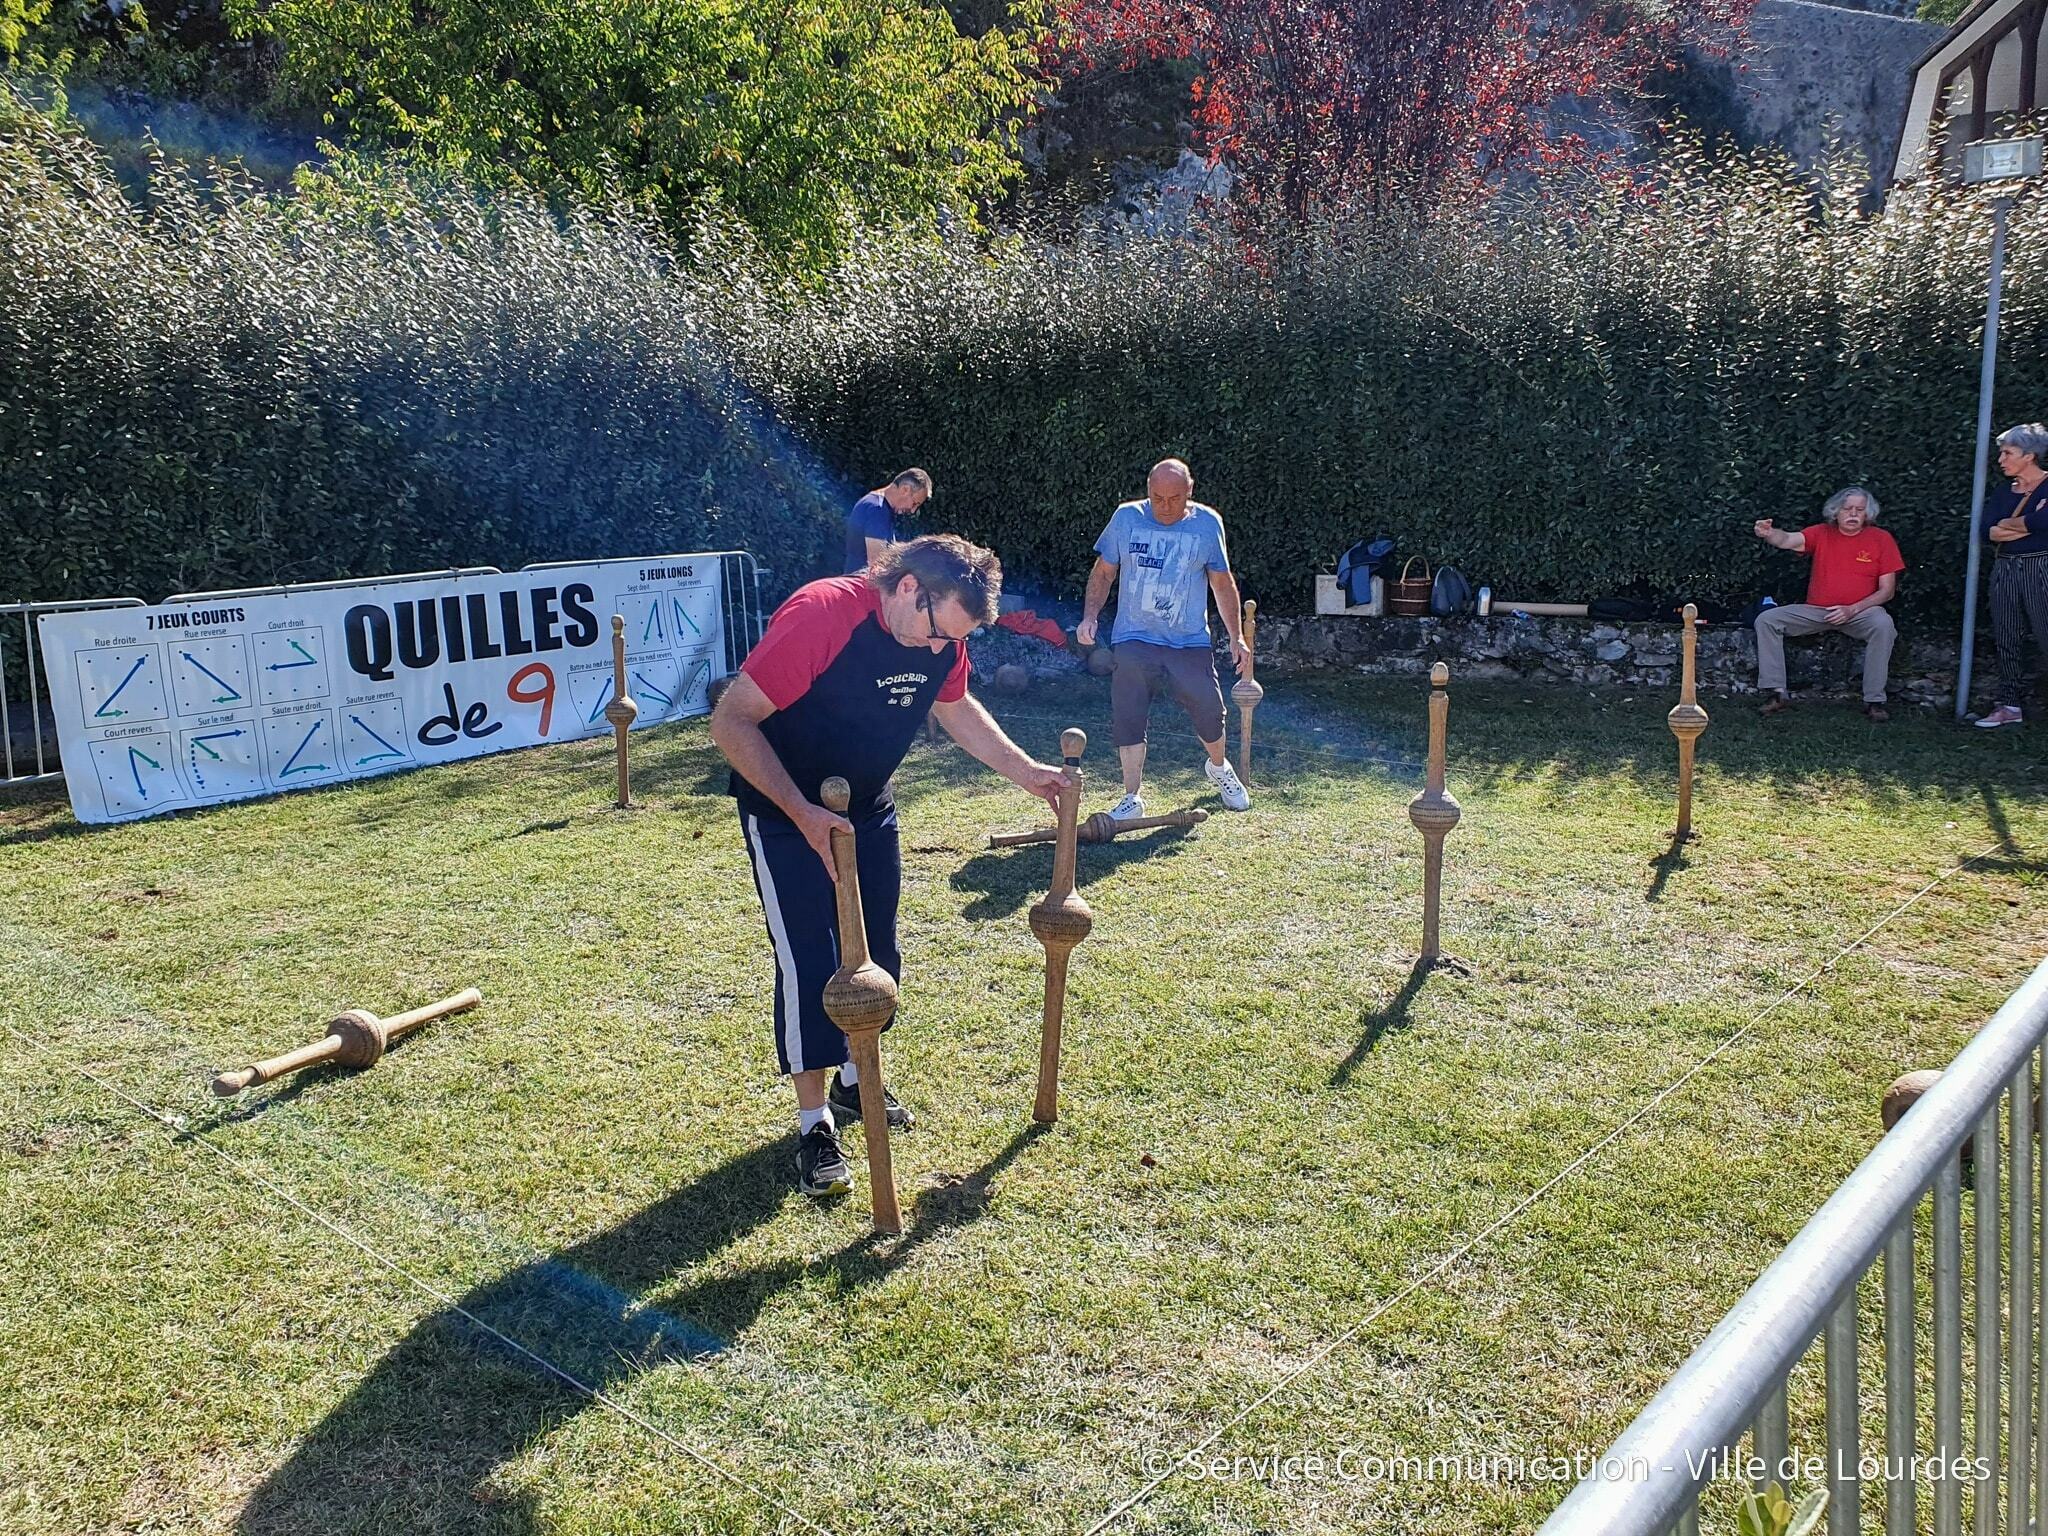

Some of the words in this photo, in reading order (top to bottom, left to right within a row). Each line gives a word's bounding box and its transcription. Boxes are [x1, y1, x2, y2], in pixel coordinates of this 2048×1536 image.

[640, 570, 646, 581] 5
[648, 568, 666, 580] JEUX
[668, 566, 693, 578] LONGS
[146, 616, 154, 630] 7
[158, 612, 190, 630] JEUX
[192, 608, 245, 626] COURTS
[268, 621, 288, 630] Court
[289, 619, 304, 628] droit
[184, 630, 198, 638] Rue
[344, 583, 599, 681] QUILLES
[94, 638, 110, 647] Rue
[112, 636, 137, 646] droite
[346, 696, 362, 705] Saute
[417, 682, 503, 746] de
[507, 662, 556, 738] 9
[272, 706, 292, 716] Saute
[306, 702, 322, 710] droit
[198, 717, 210, 726] Sur
[210, 715, 219, 724] le
[104, 728, 126, 738] Court
[128, 726, 153, 735] revers
